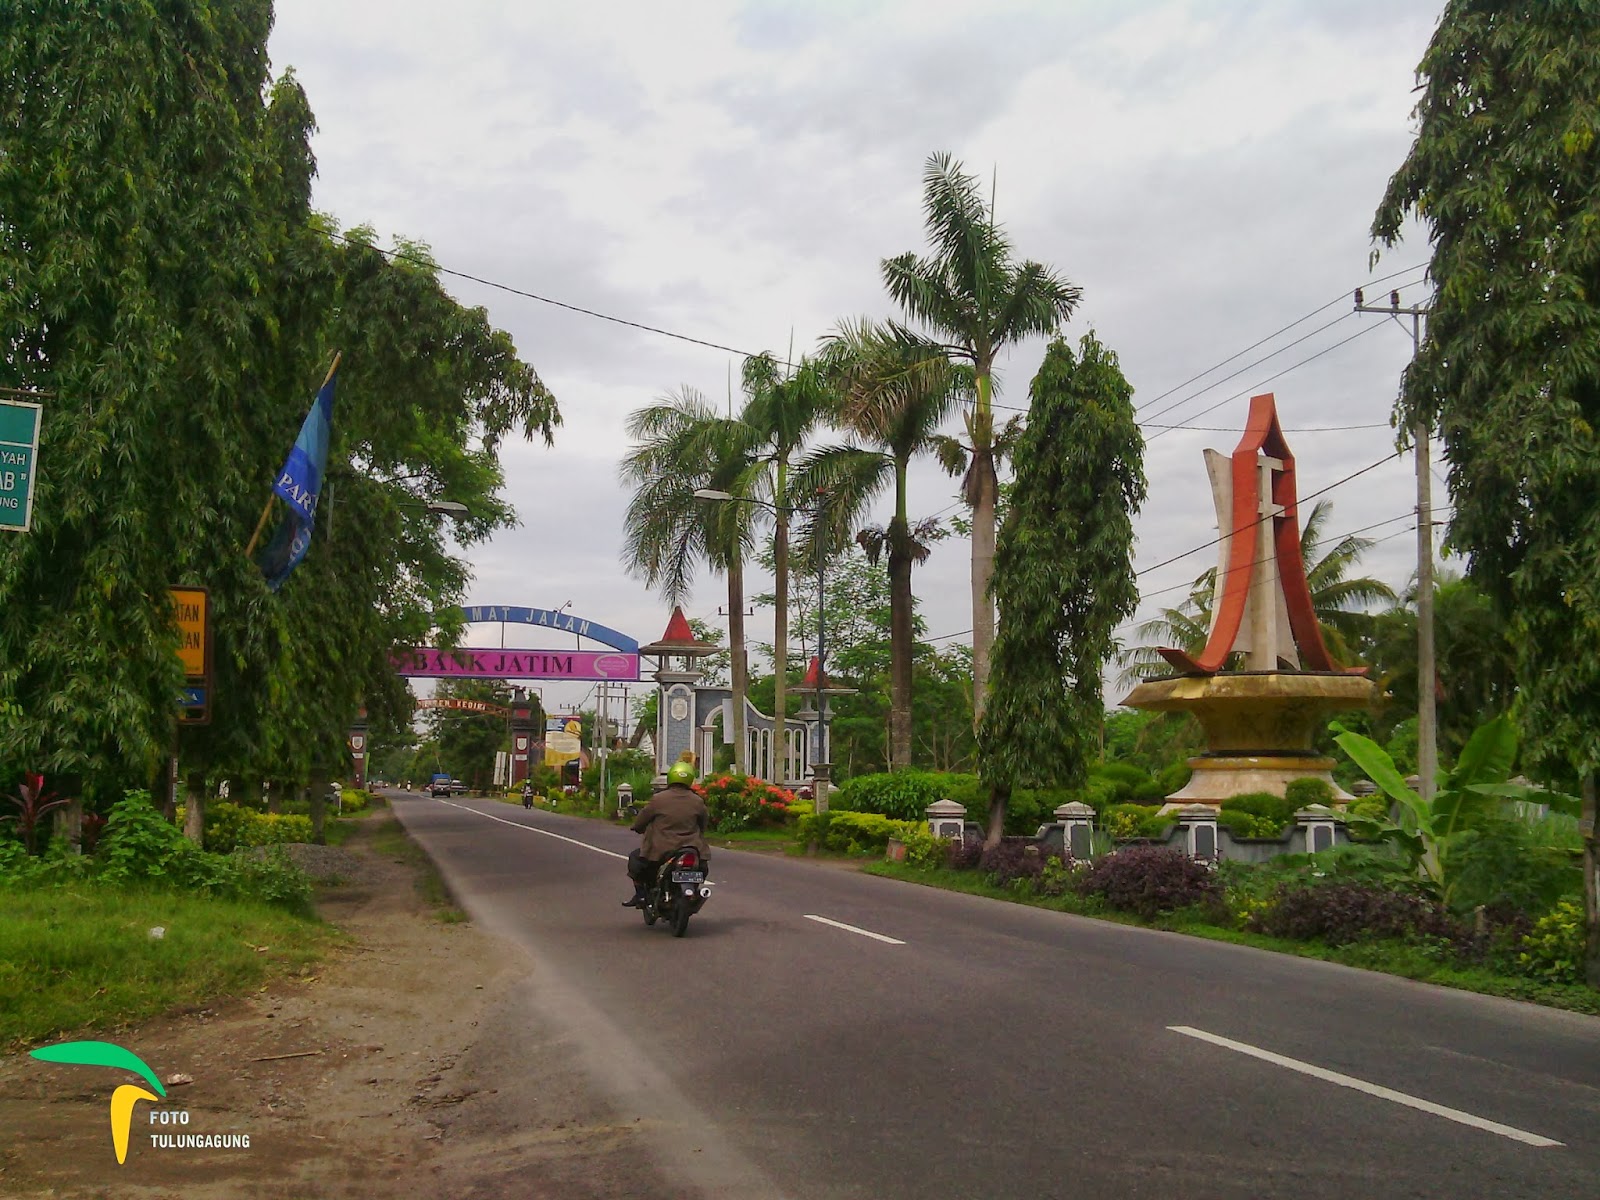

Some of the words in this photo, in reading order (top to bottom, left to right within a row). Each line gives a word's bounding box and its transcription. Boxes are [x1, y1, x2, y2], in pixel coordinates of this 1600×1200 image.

[526, 609, 590, 635] JALAN
[413, 653, 487, 672] BANK
[494, 655, 574, 674] JATIM
[456, 700, 486, 711] KEDIRI
